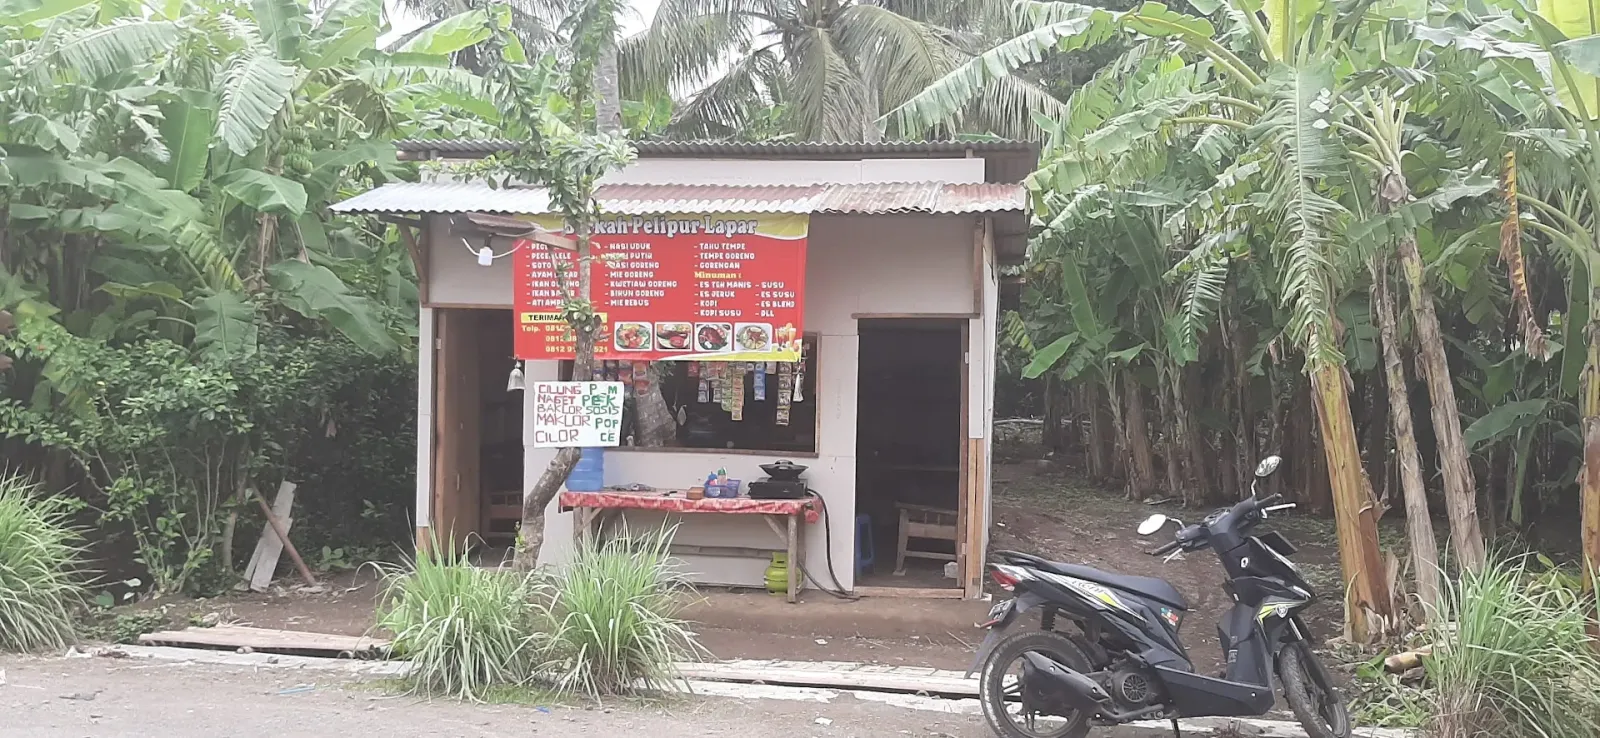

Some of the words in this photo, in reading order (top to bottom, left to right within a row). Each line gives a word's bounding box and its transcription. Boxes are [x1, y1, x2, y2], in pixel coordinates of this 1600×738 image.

[631, 215, 700, 238] Pelipur
[702, 215, 759, 238] Lapar
[554, 252, 571, 260] LELE
[629, 252, 653, 260] PUTIH
[700, 252, 724, 260] TEMPE
[725, 252, 755, 260] GORENG
[694, 271, 737, 279] Minuman
[761, 281, 784, 289] SUSU
[700, 290, 709, 298] ES
[711, 290, 735, 298] JERUK
[761, 290, 771, 298] ES
[531, 299, 544, 307] ATI
[700, 309, 718, 317] KOPI
[719, 309, 742, 317] SUSU
[538, 384, 582, 395] CILUNG
[537, 394, 576, 405] NAGET
[537, 404, 583, 415] BAKLOR
[585, 405, 620, 415] SOSIS
[536, 413, 591, 427] MAKLOR
[595, 417, 619, 430] POP
[535, 429, 579, 443] CILOR
